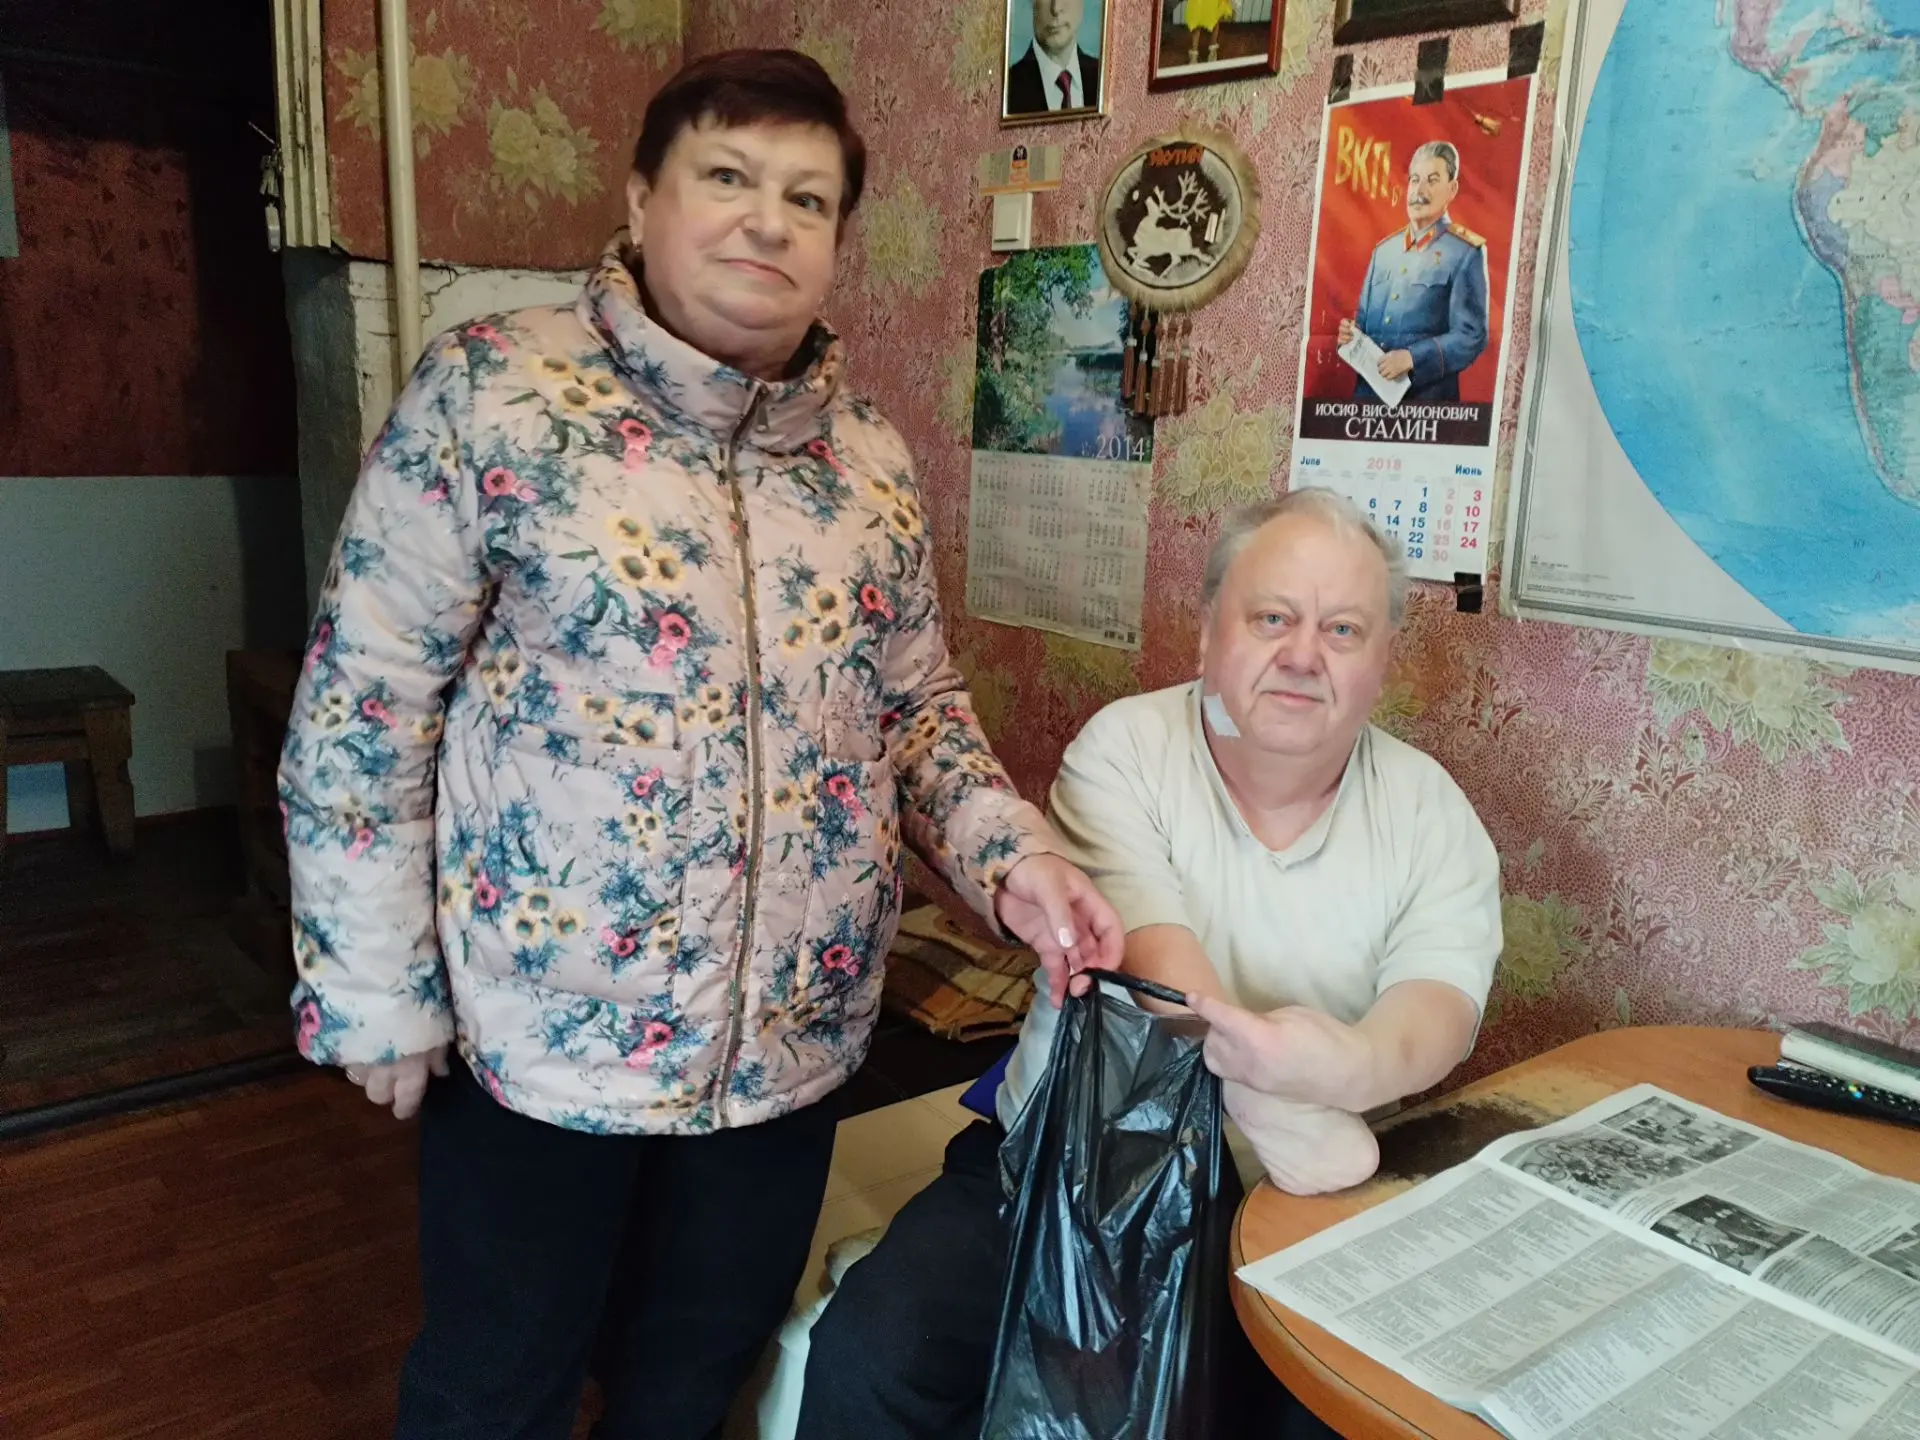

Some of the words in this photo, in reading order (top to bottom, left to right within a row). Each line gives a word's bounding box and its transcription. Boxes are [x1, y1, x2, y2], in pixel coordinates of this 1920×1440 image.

[1315, 403, 1358, 417] ИОСИФ
[1362, 404, 1479, 421] ВИССАРИОНОВИЧ
[1344, 417, 1438, 441] СТАЛИН
[1095, 434, 1144, 461] 2014
[1300, 456, 1321, 466] June
[1366, 456, 1403, 471] 2018
[1455, 464, 1482, 476] Июнь
[1422, 486, 1428, 498] 1
[1447, 488, 1455, 500] 2
[1473, 490, 1482, 502] 3
[1369, 498, 1377, 509] 6
[1394, 500, 1402, 511] 7
[1419, 502, 1427, 513] 8
[1465, 506, 1480, 517] 10
[1386, 515, 1400, 526] 14
[1411, 517, 1425, 529] 15
[1463, 521, 1479, 533] 17
[1408, 532, 1424, 544] 22
[1460, 536, 1477, 548] 24
[1407, 547, 1423, 559] 29
[1433, 550, 1448, 561] 30
